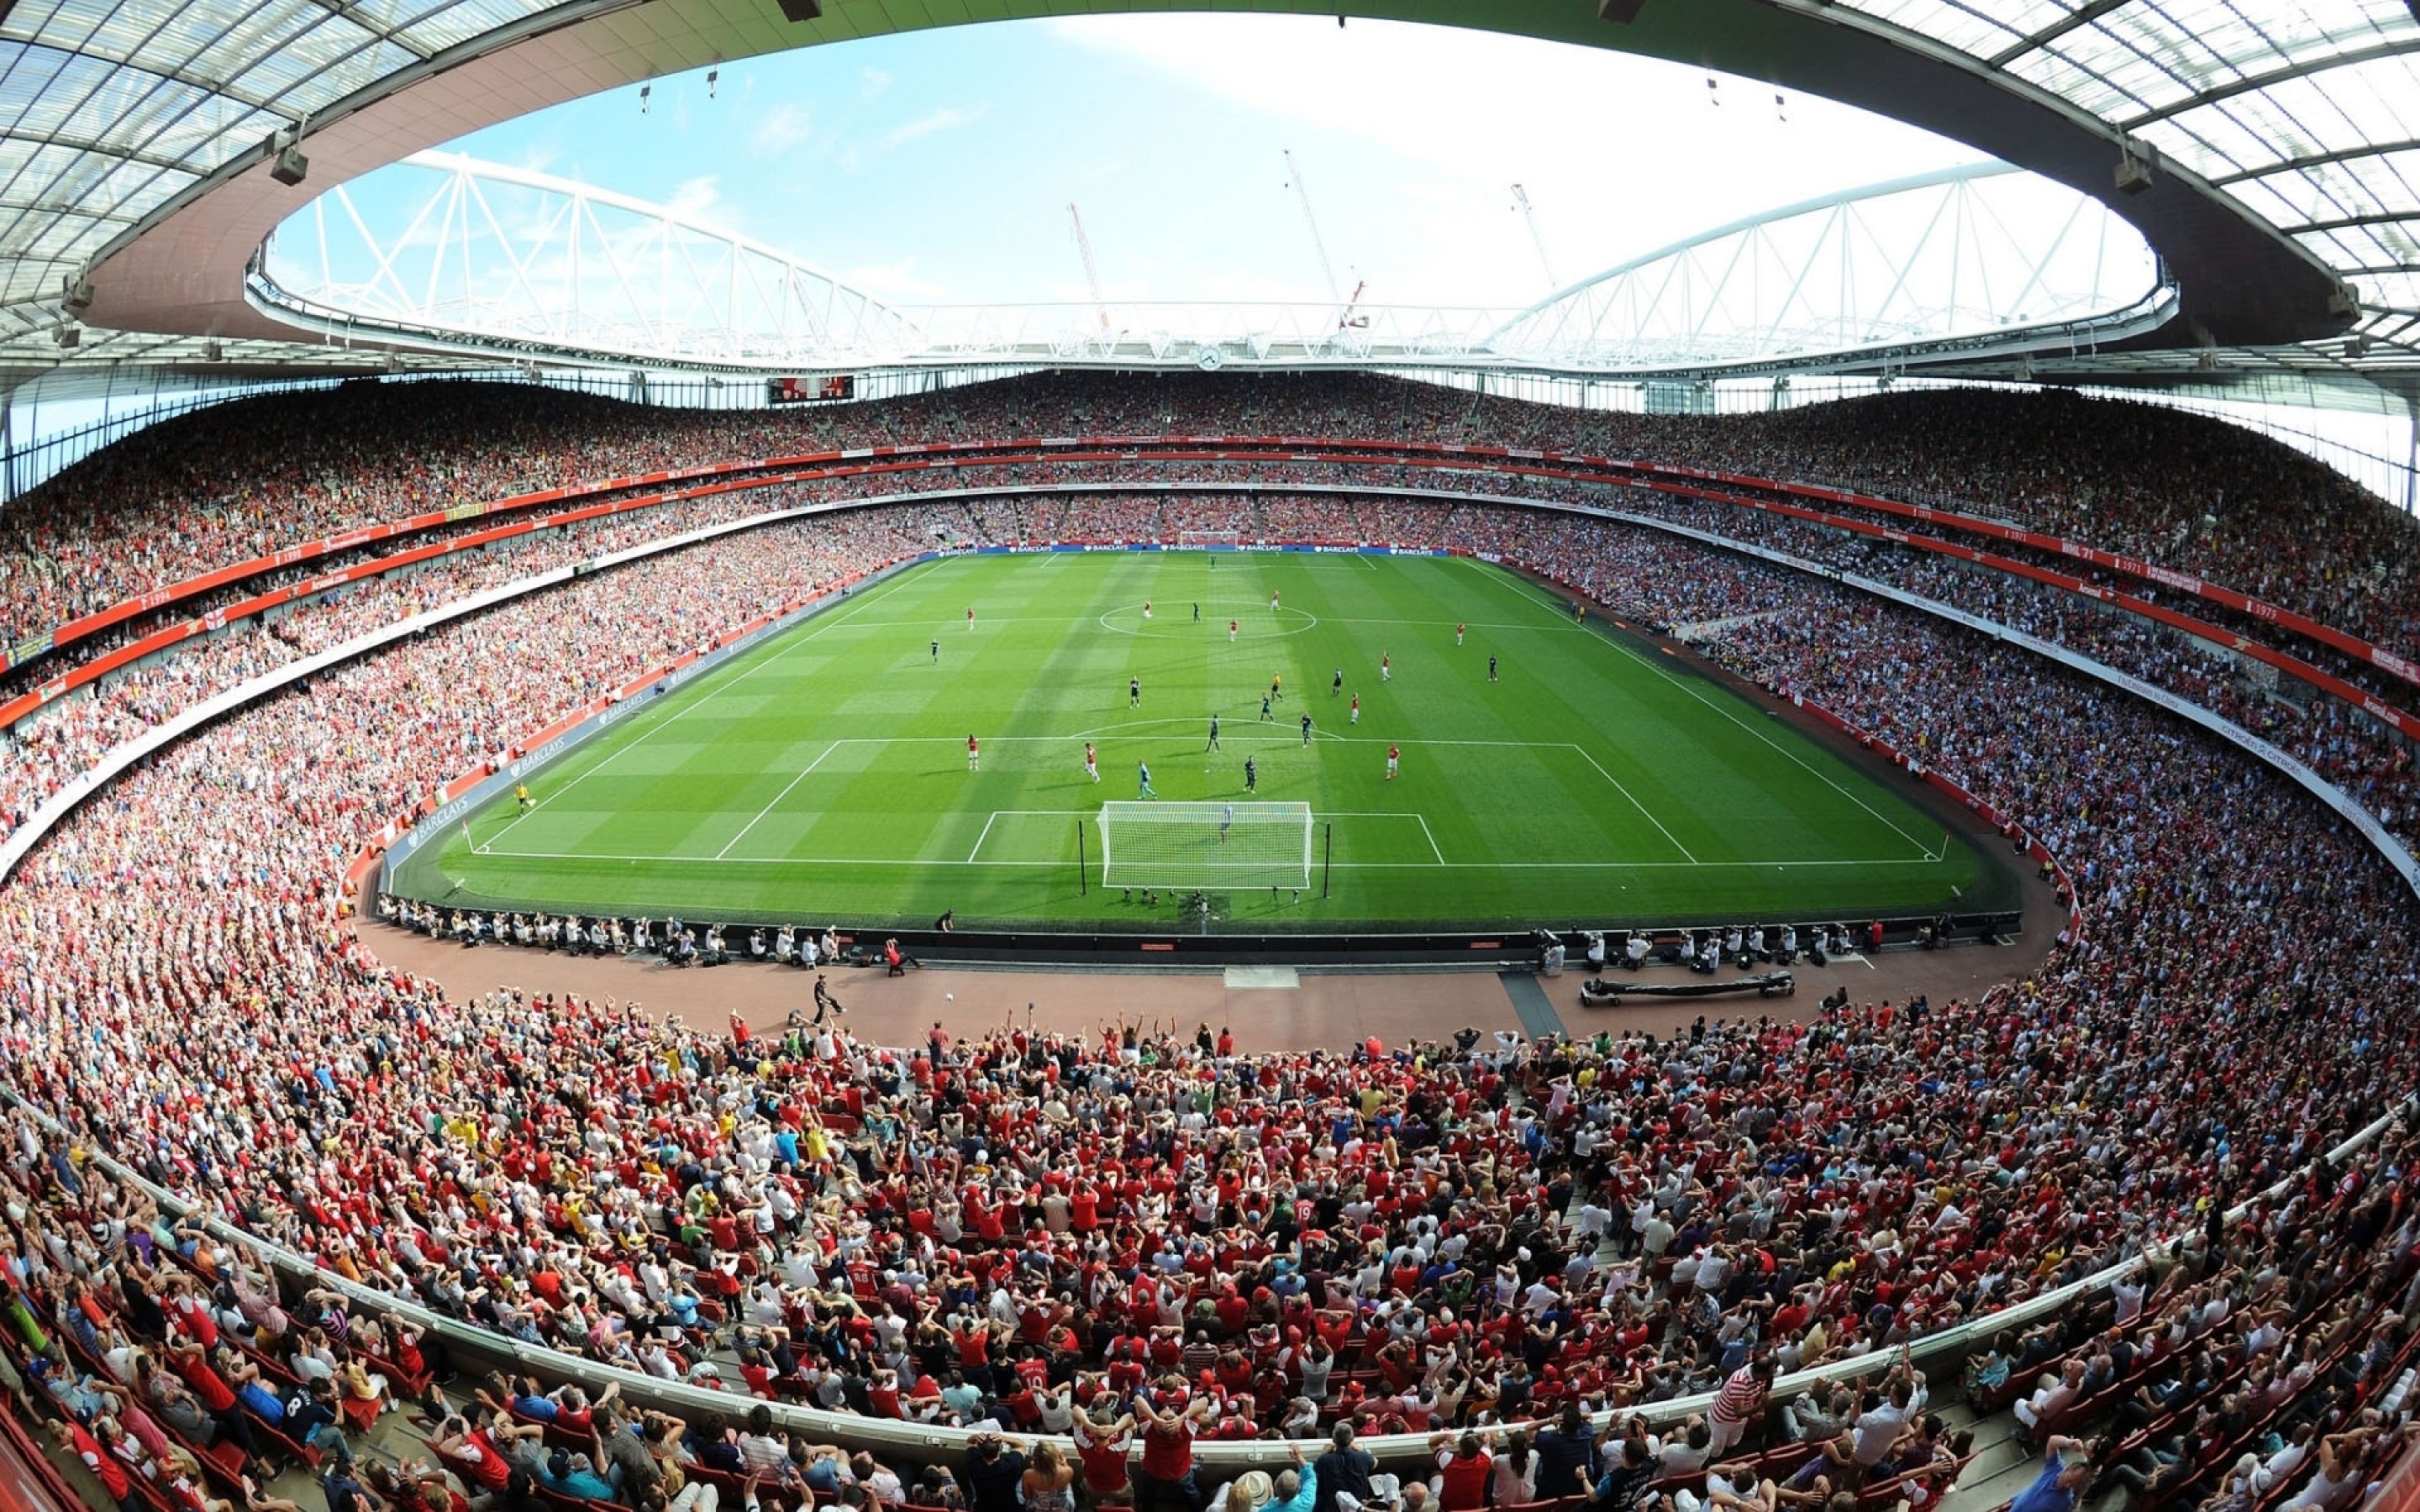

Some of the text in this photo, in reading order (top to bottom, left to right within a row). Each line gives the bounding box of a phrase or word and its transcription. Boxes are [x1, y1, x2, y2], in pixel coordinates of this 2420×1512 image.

[1398, 548, 1433, 556] BARCLAYS
[608, 694, 644, 720] BARCLAYS
[521, 736, 565, 769] BARCLAYS
[419, 795, 469, 839] BARCLAYS
[1298, 1206, 1310, 1221] 19
[287, 1396, 302, 1417] 8
